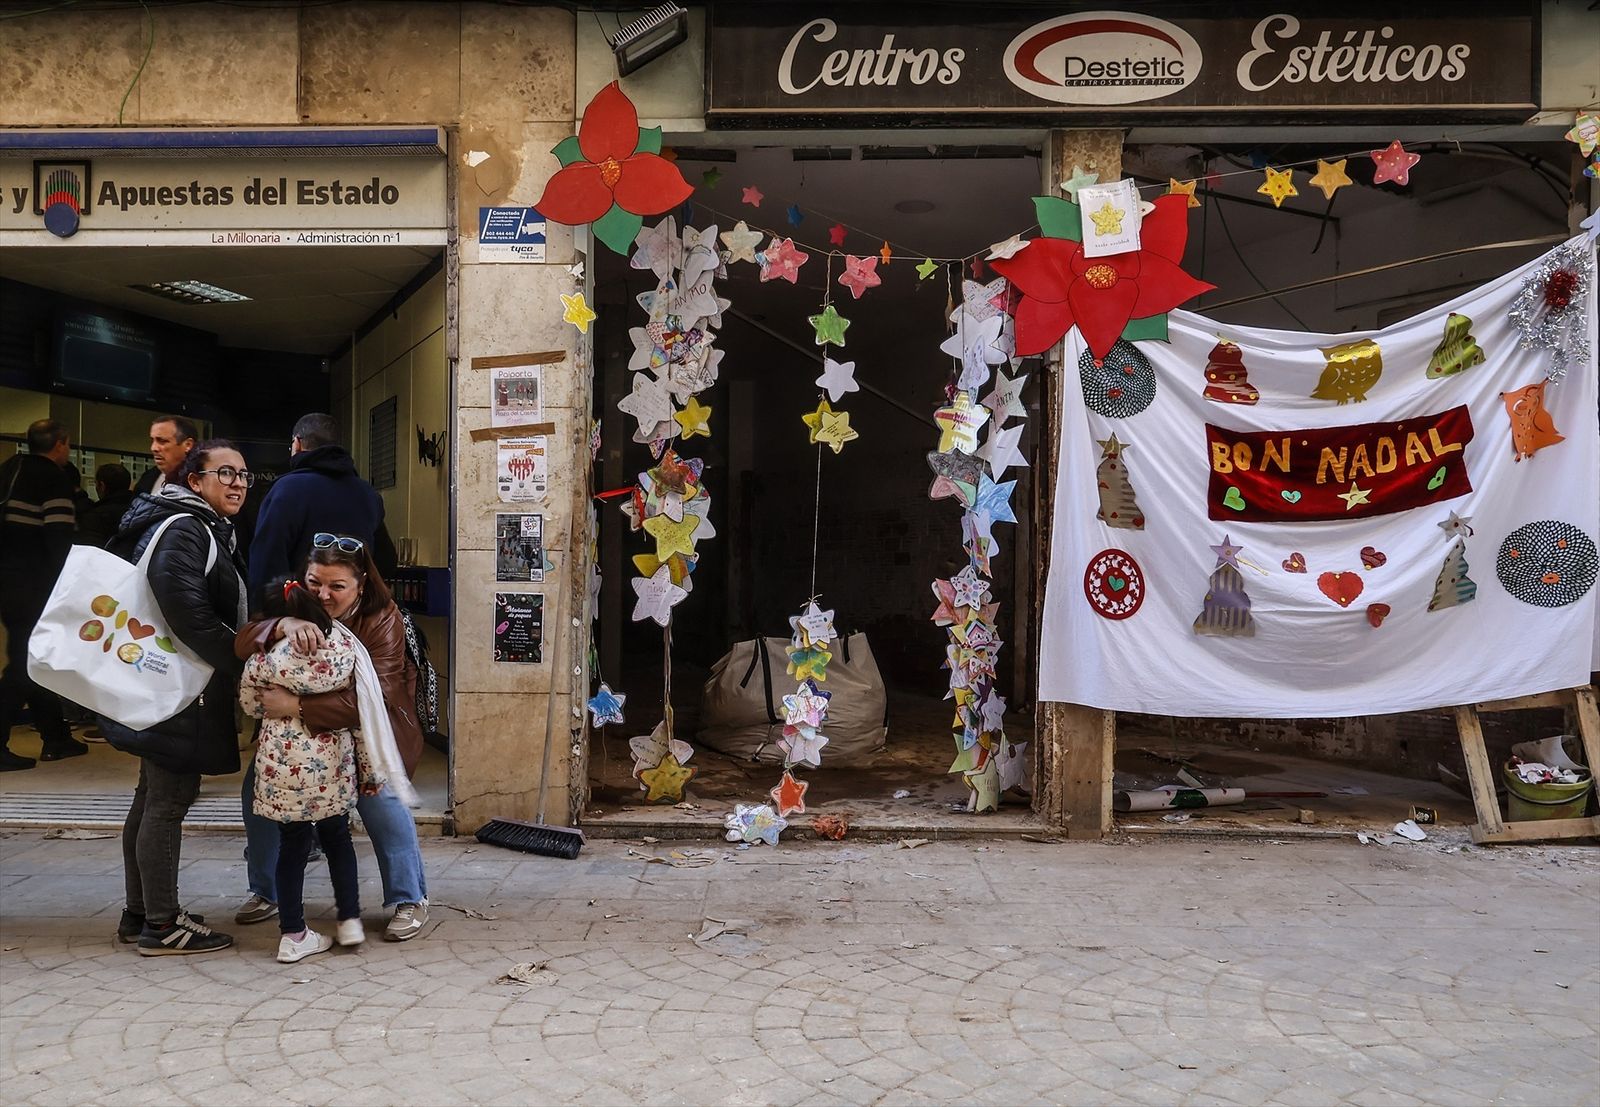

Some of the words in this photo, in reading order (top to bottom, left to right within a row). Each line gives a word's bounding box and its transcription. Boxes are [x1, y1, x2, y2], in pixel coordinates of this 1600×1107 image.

[778, 18, 965, 95] Centros
[1236, 13, 1471, 92] Estéticos
[1065, 57, 1184, 78] Destetic
[12, 187, 28, 213] y
[97, 180, 234, 211] Apuestas
[243, 177, 287, 205] del
[296, 177, 399, 205] Estado
[211, 233, 224, 243] La
[227, 232, 281, 243] Millonaria
[297, 232, 380, 243] Administración
[511, 245, 533, 253] tyco
[1211, 438, 1292, 474] BON
[1316, 427, 1463, 485] NADAL
[145, 656, 170, 669] Central
[147, 650, 167, 661] World
[142, 662, 168, 676] Kitchen
